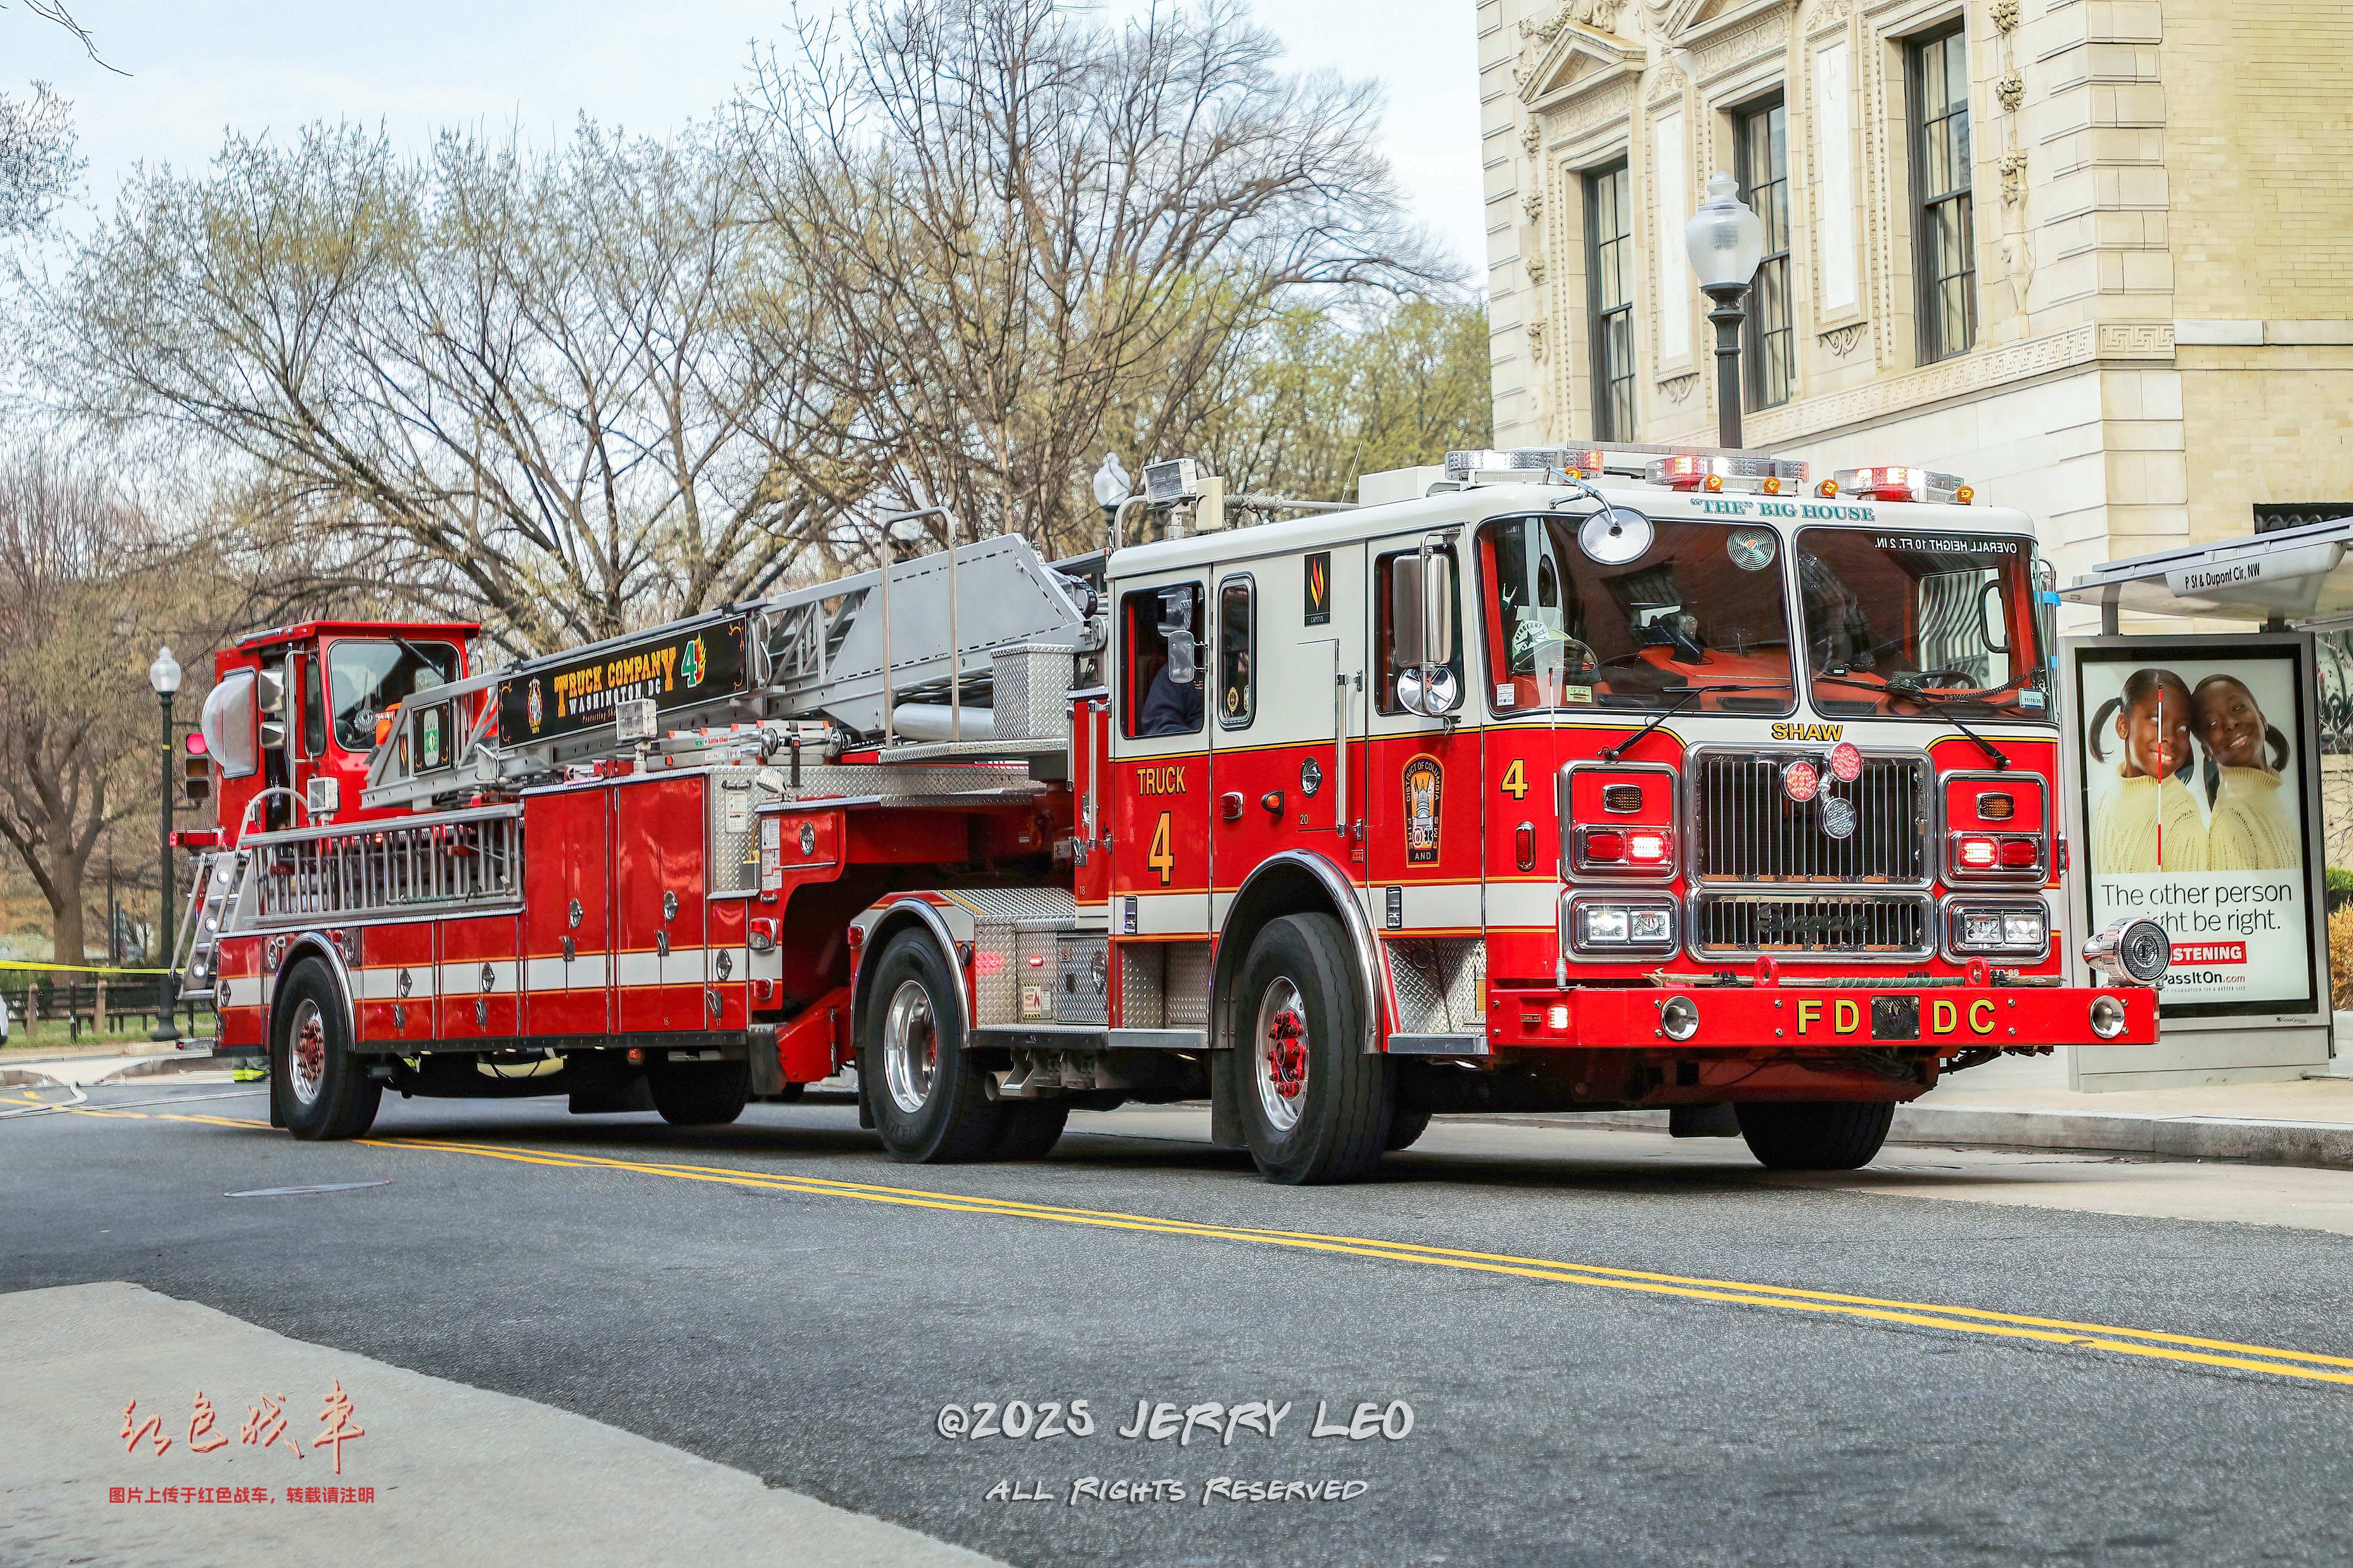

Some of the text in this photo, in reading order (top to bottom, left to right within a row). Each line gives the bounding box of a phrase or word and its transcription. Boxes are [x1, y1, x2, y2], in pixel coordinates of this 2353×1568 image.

[1757, 502, 1797, 518] BIG
[1800, 504, 1876, 522] HOUSE
[2185, 562, 2260, 590] P St & Dupont Cir, NW
[554, 640, 697, 717] TRUCK COMPANY 4
[648, 678, 661, 697] DC
[1772, 723, 1843, 742] SHAW
[1137, 765, 1186, 796] TRUCK
[1406, 765, 1417, 802] DISTRICT
[1425, 762, 1440, 800] COLUMBIA
[1501, 759, 1529, 801] 4
[1299, 813, 1309, 825] 20
[1147, 810, 1175, 887] 4
[1079, 885, 1086, 895] 18
[2101, 883, 2292, 907] The other person
[2194, 910, 2221, 932] be
[2228, 908, 2281, 935] right.
[2171, 946, 2243, 962] STENING
